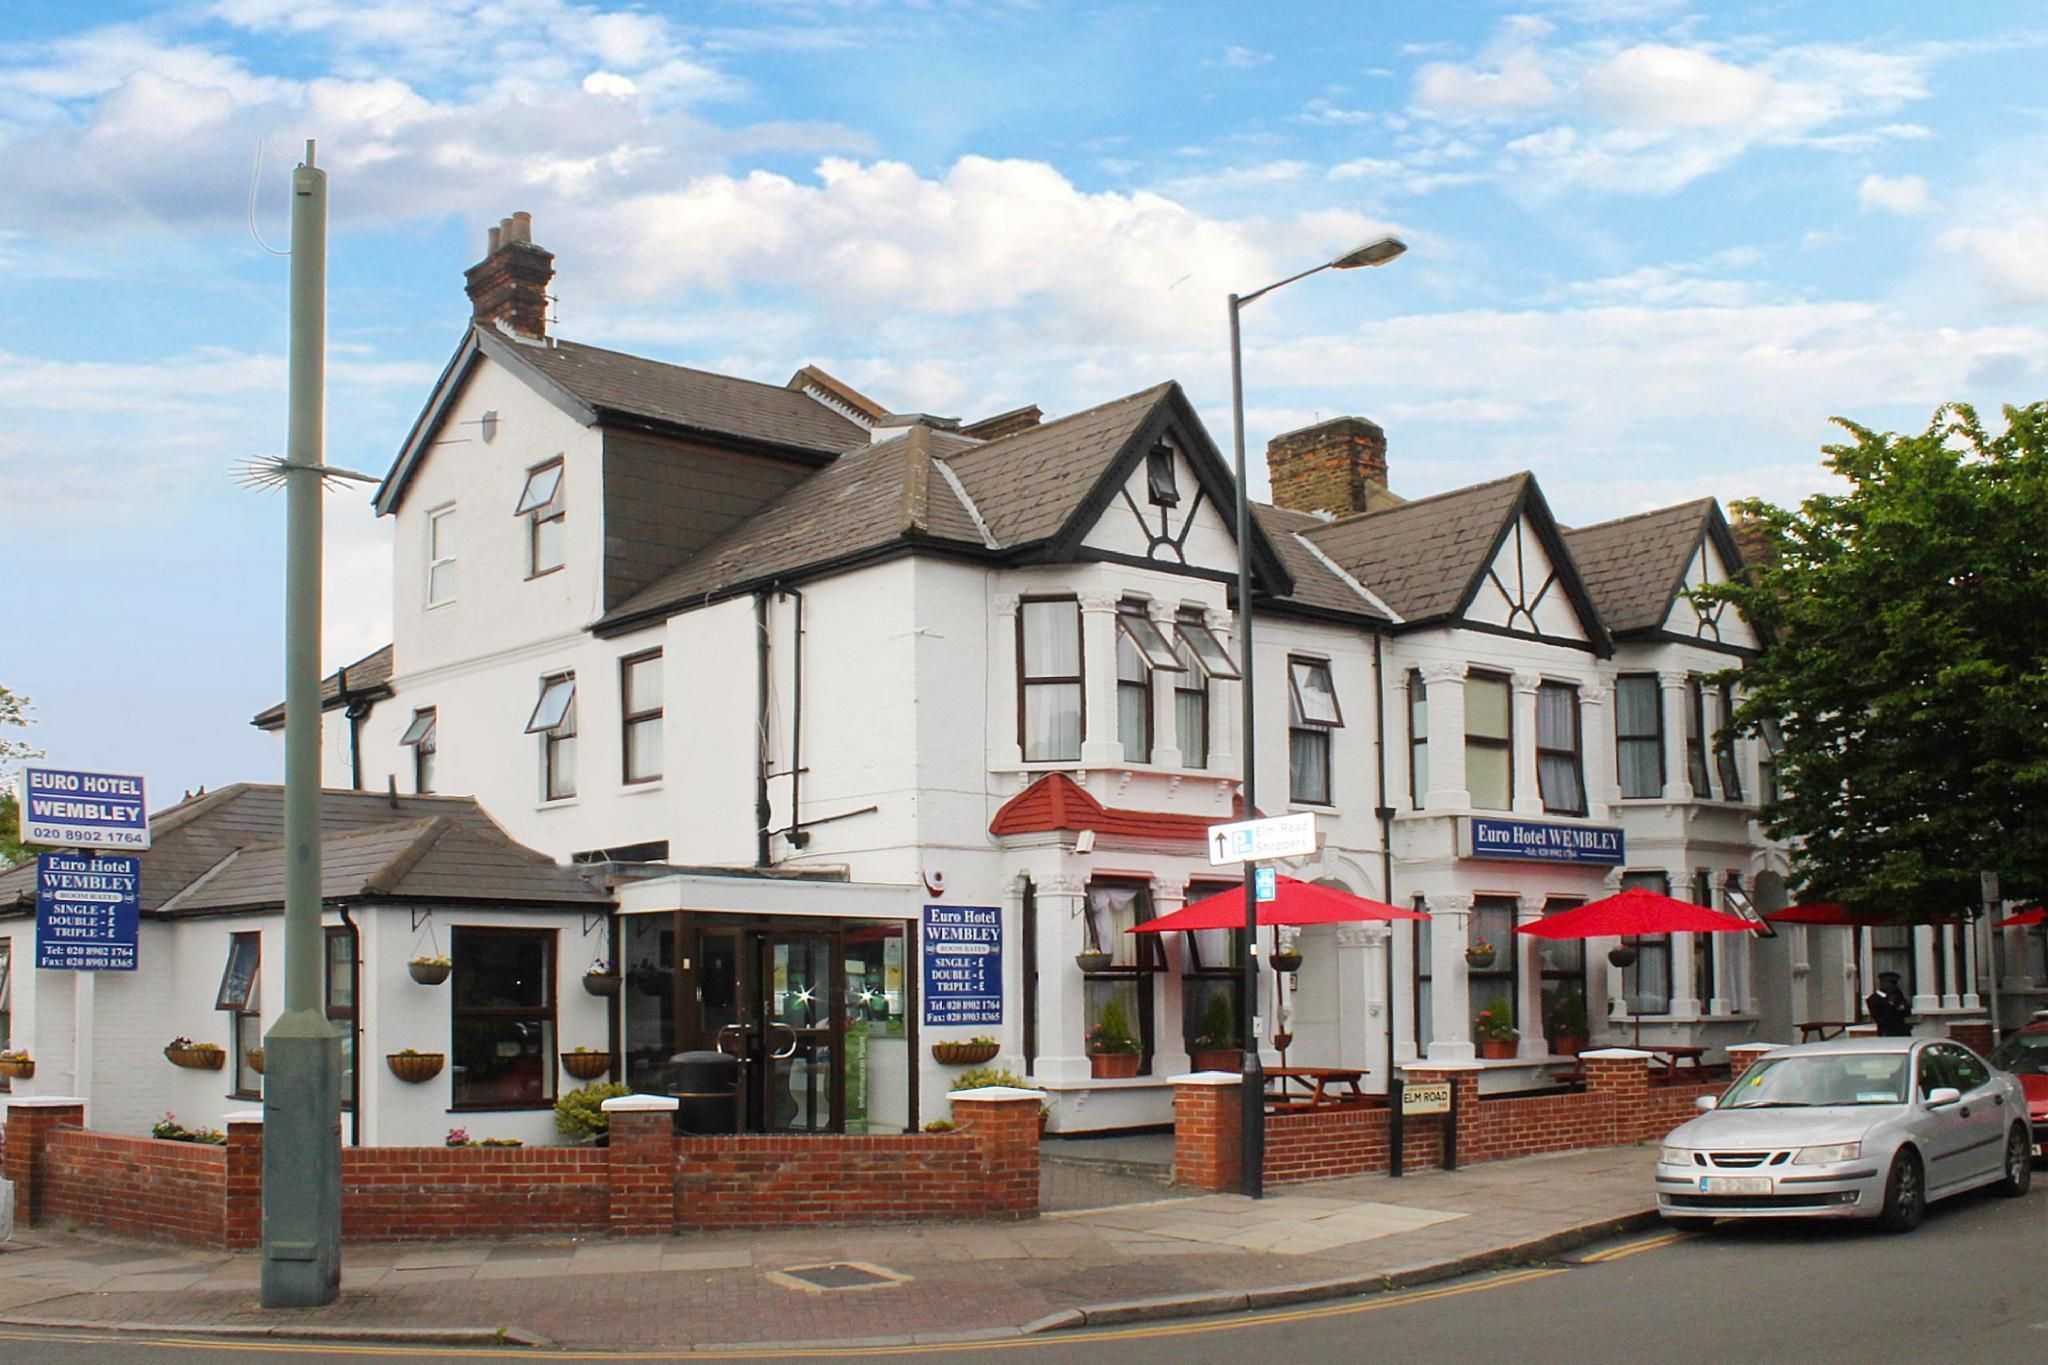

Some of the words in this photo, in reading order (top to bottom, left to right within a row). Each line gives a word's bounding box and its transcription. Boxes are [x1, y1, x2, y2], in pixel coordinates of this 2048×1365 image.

[30, 772, 78, 791] EURO
[84, 776, 140, 795] HOTEL
[32, 800, 140, 822] WEMBLEY
[1280, 820, 1308, 832] Road
[34, 828, 60, 839] 020
[66, 830, 102, 841] 8902
[109, 832, 142, 843] 1764
[1478, 824, 1510, 843] Euro
[1514, 827, 1546, 845] Hotel
[1549, 829, 1619, 850] WEMBLEY
[49, 857, 85, 871] Euro
[90, 859, 130, 873] Hotel
[44, 874, 135, 890] WEMBLEY
[54, 905, 98, 915] SINGLE
[48, 916, 98, 926] DOUBLE
[931, 909, 961, 922] Euro
[964, 911, 996, 924] Hotel
[54, 928, 98, 938] TRIPLE
[927, 928, 1000, 940] WEMBLEY
[46, 946, 64, 955] Tel:
[67, 947, 84, 955] 020
[112, 948, 133, 956] 1764
[42, 957, 63, 966] Fax:
[66, 958, 84, 966] 020
[936, 958, 971, 967] SINGLE
[932, 970, 971, 980] DOUBLE
[936, 982, 971, 992] TRIPLE
[927, 1013, 945, 1022] Fax:
[1404, 1093, 1421, 1103] ELM
[1424, 1091, 1448, 1102] ROAD
